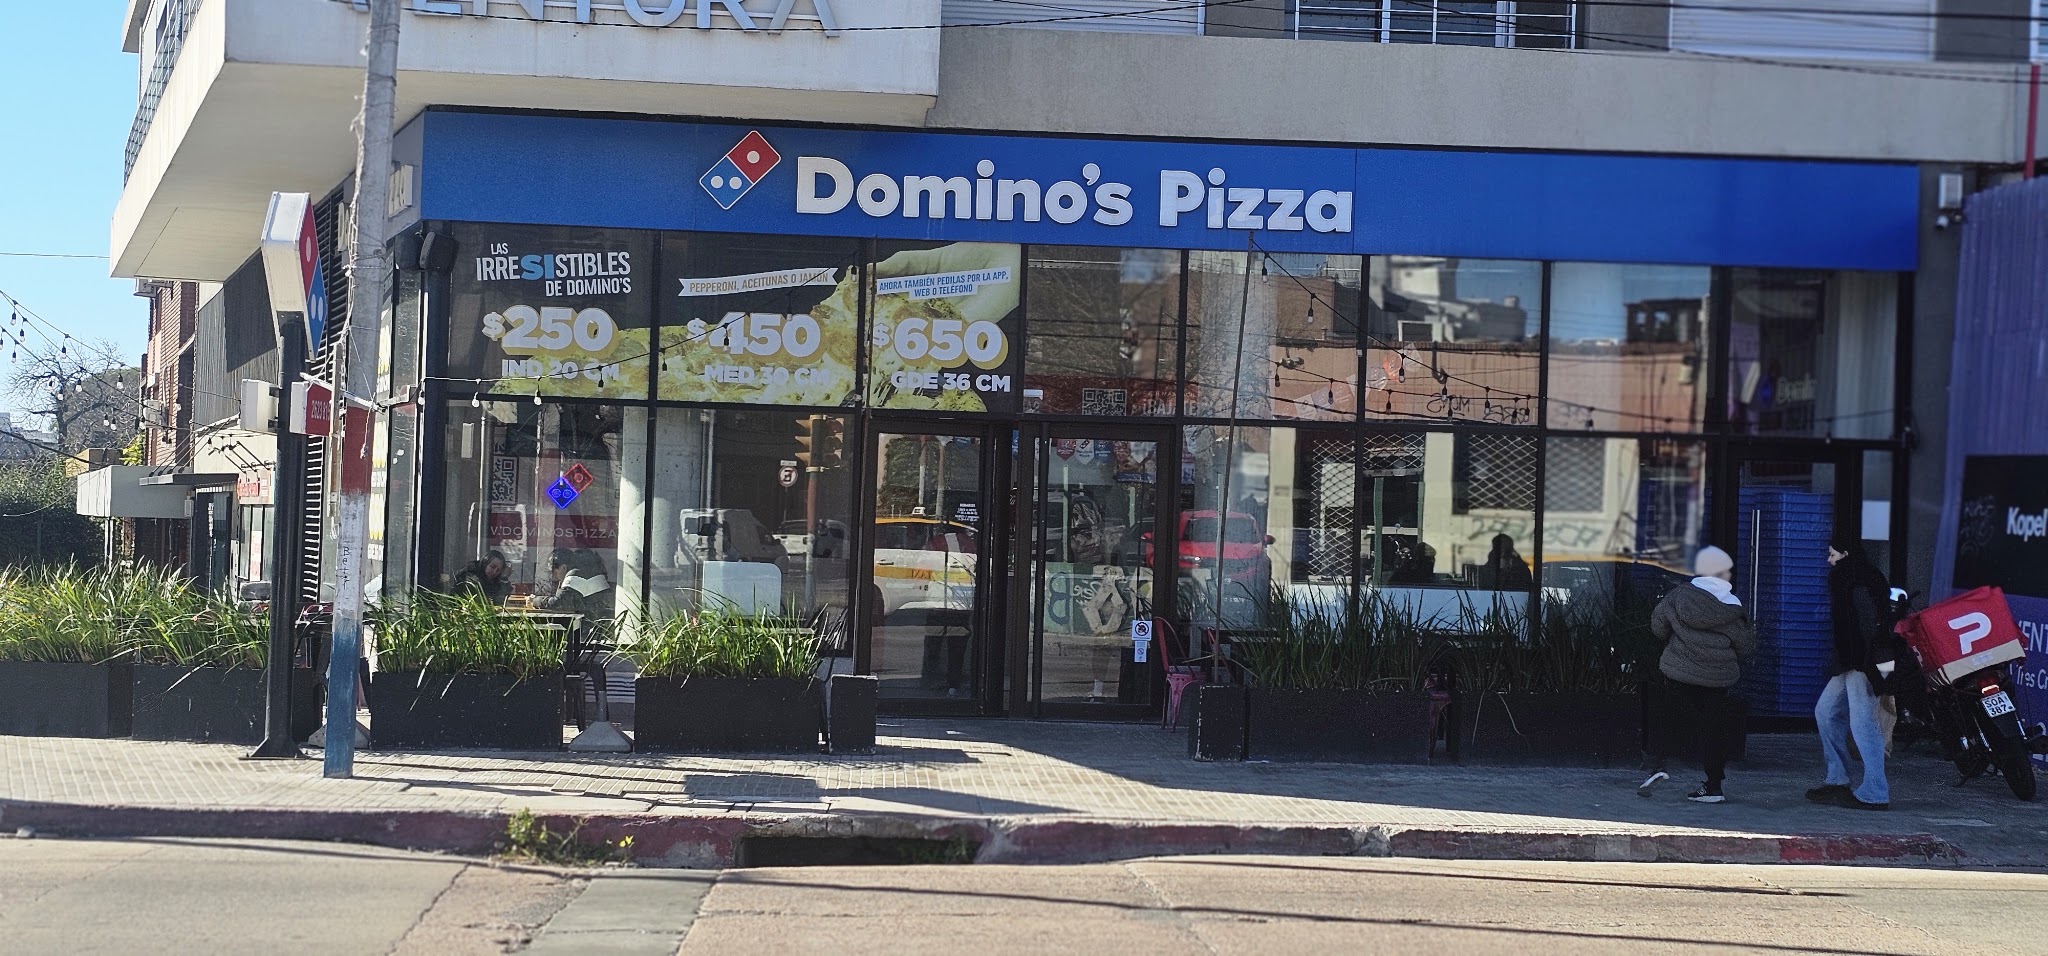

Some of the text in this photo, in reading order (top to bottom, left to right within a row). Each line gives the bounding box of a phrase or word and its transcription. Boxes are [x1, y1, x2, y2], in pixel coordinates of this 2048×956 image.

[797, 156, 1352, 233] Domino's Pizza
[490, 243, 508, 255] LAS
[476, 252, 631, 281] IRRESISTIBLES
[545, 278, 632, 296] DE DOMINO'S
[689, 281, 740, 293] PEPPERONI,
[742, 274, 789, 290] ACEITUNAS
[790, 273, 797, 284] O
[879, 281, 903, 291] AHORA
[904, 275, 935, 289] TAMBIÉN
[937, 274, 966, 285] PEDILAS
[967, 273, 981, 283] POR
[982, 272, 992, 282] LA
[914, 287, 931, 298] WEB
[932, 287, 938, 296] O
[482, 304, 619, 355] $250
[686, 312, 824, 360] $450
[872, 318, 1007, 366] $650
[501, 359, 621, 384] IND 20 CM
[704, 364, 830, 387] MED 30 CM
[890, 371, 1012, 392] GDE 36 CM
[2006, 506, 2048, 542] Kopel
[1984, 696, 2005, 709] SOA
[1989, 704, 2007, 716] 387
